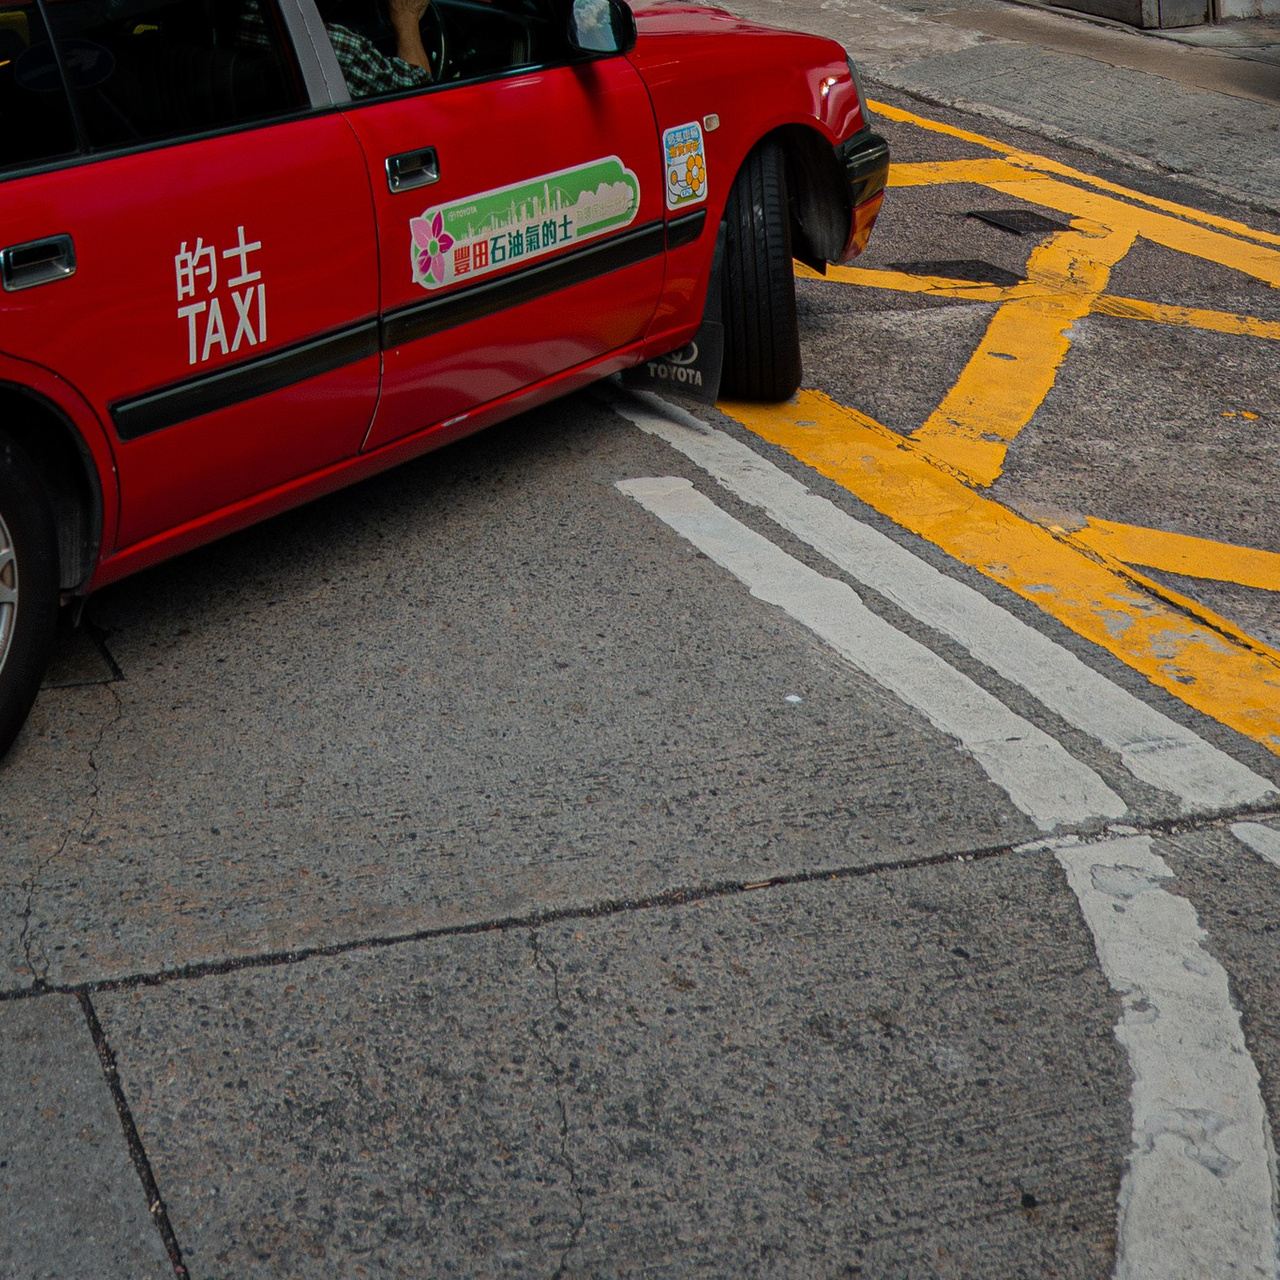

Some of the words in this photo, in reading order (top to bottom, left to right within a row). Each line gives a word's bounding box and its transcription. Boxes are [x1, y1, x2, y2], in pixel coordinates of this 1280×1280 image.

[174, 225, 262, 302] 的士
[453, 214, 573, 277] 豐田石油氣的士
[177, 283, 267, 365] TAXI
[647, 362, 703, 386] TOYOTA
